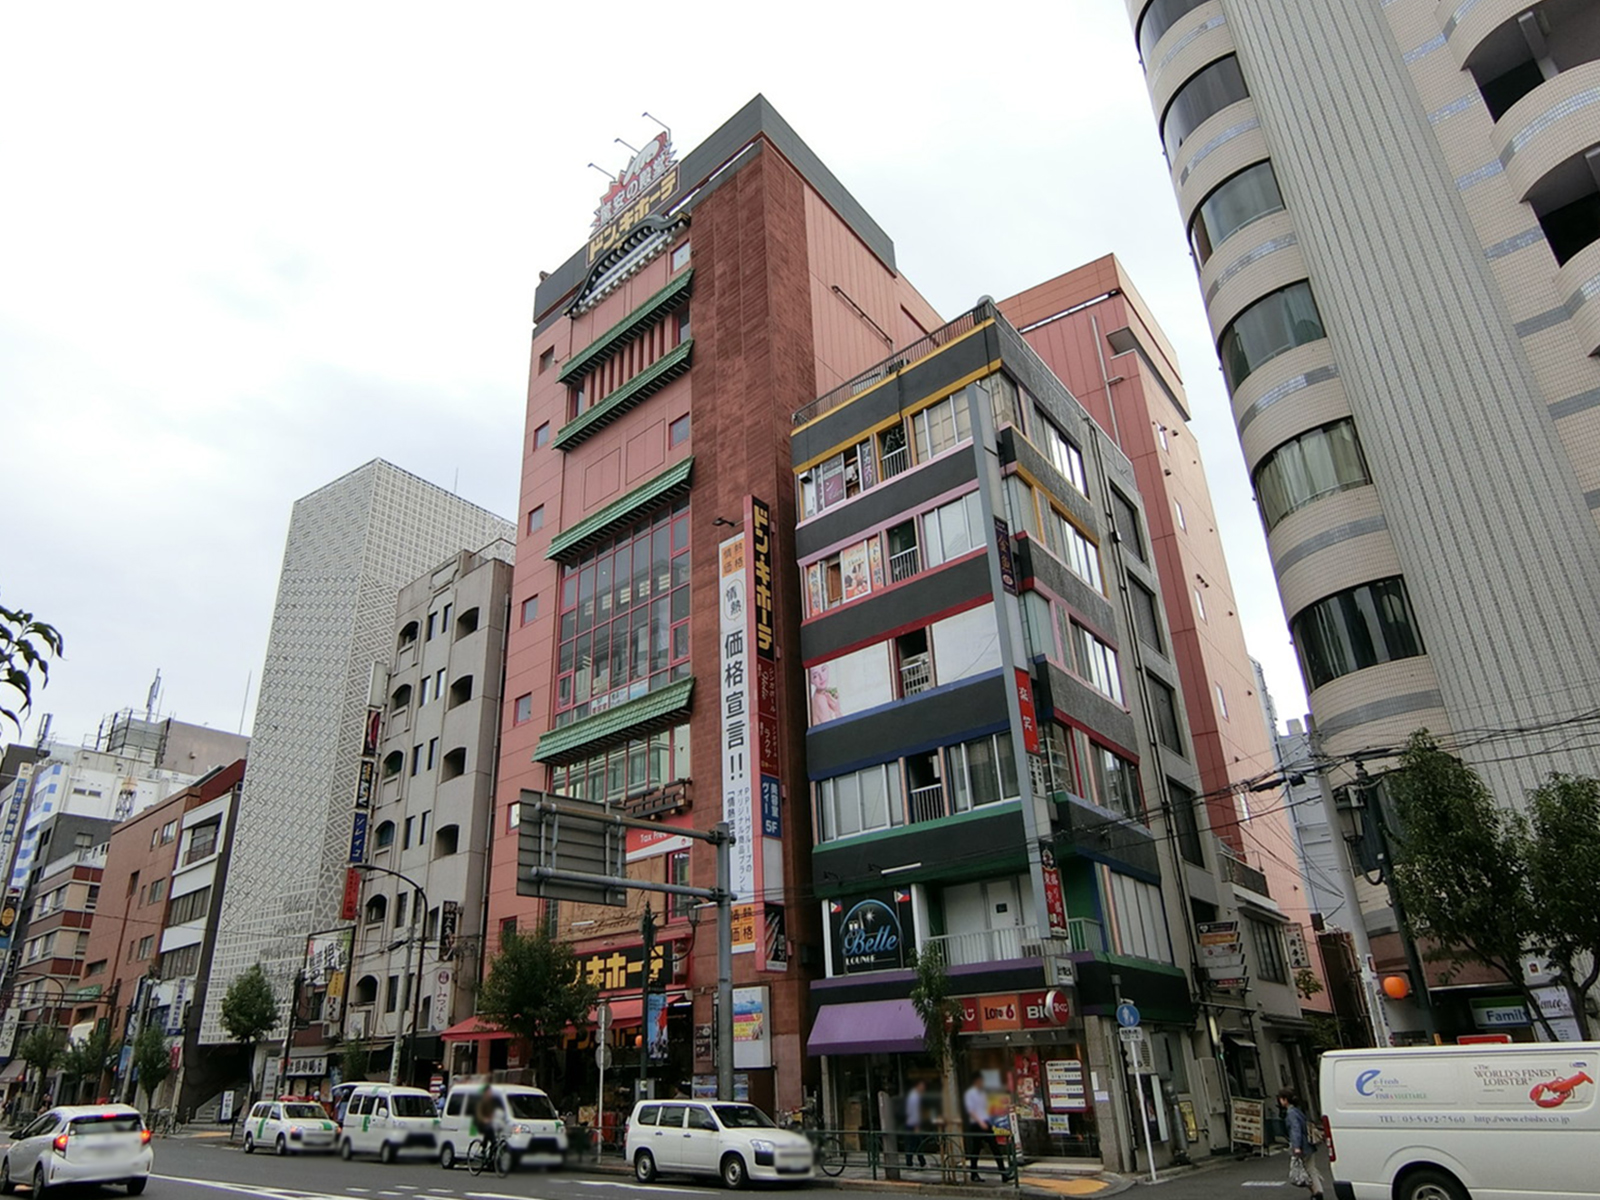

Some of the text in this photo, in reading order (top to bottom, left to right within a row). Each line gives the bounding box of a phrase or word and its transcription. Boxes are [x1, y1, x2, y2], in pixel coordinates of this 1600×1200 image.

[765, 819, 778, 834] 5F
[844, 924, 899, 956] Belle
[1006, 1004, 1015, 1019] 6
[1521, 1068, 1558, 1078] FINEST
